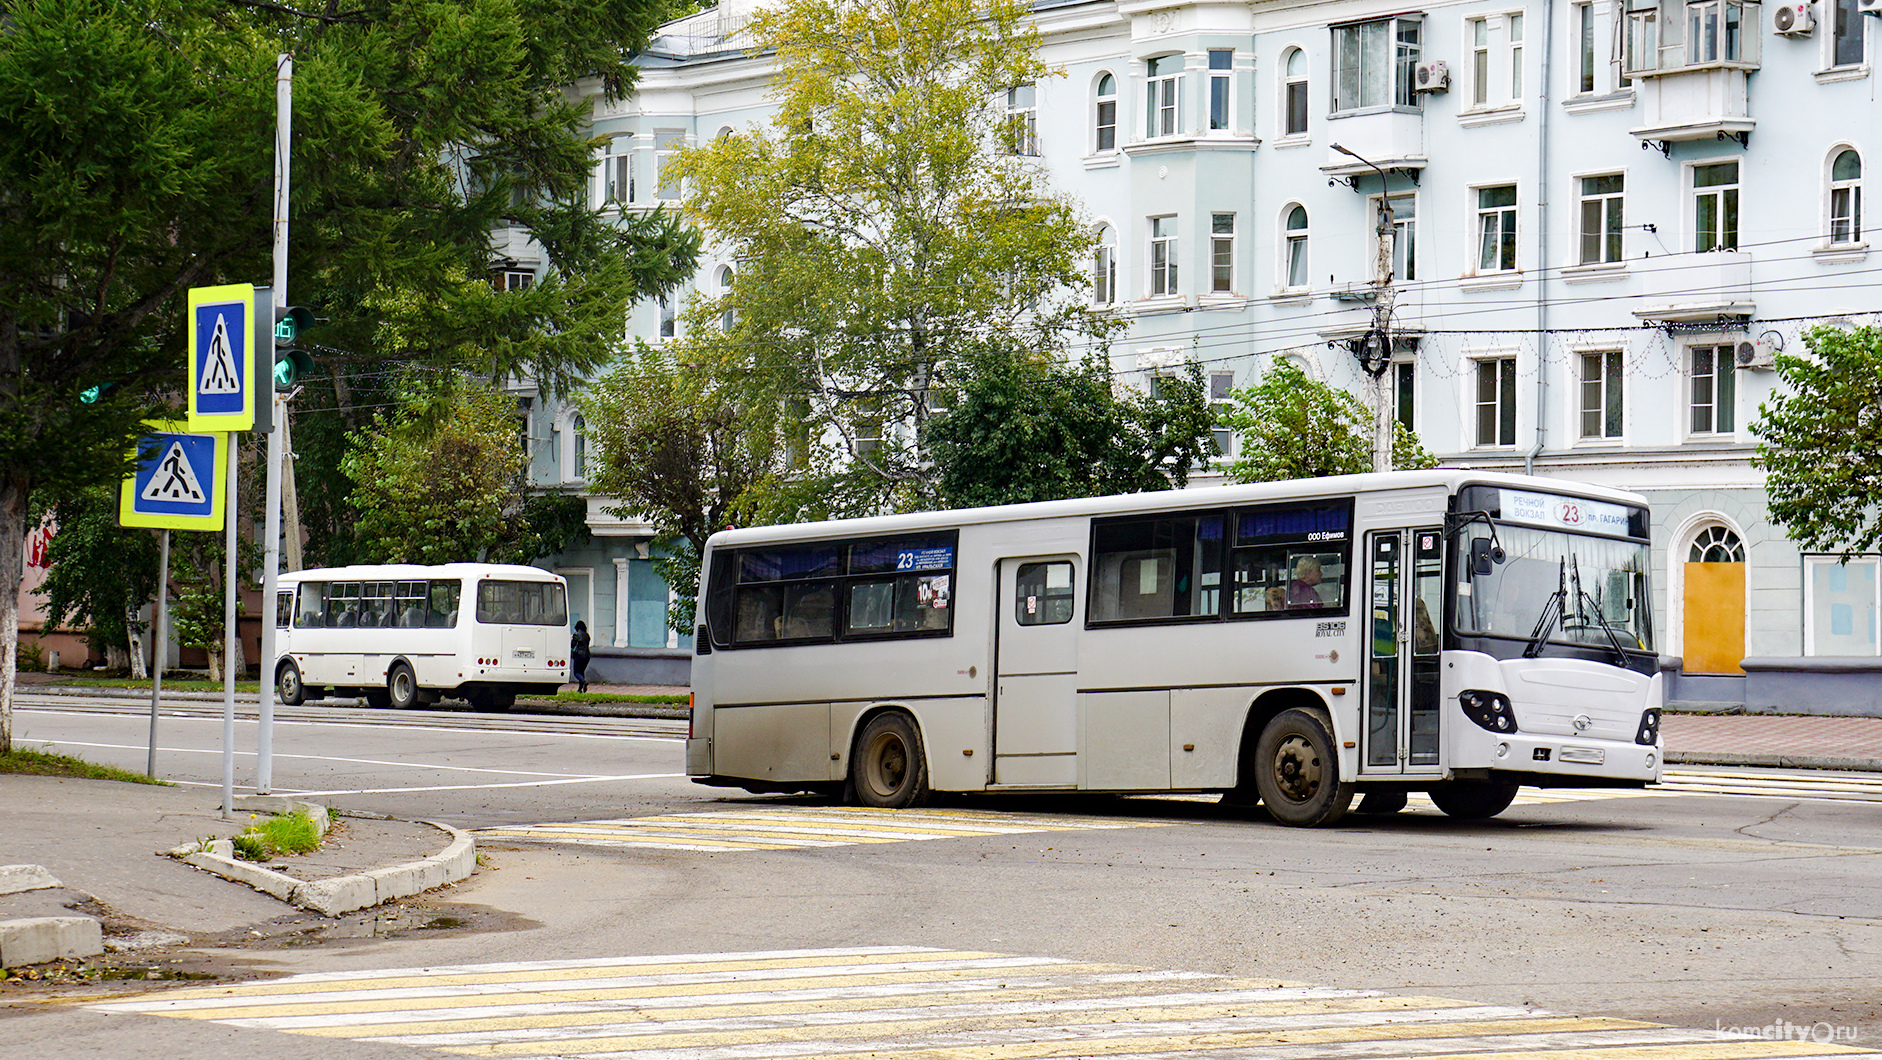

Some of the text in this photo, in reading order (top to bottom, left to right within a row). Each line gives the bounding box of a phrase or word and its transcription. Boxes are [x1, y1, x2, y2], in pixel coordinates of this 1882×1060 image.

[1513, 496, 1545, 508] РЕЧНОЙ
[1514, 507, 1545, 520] ВОКЗАЛ
[1562, 504, 1580, 523] 23
[1308, 532, 1321, 541] ООО
[897, 552, 914, 569] 23
